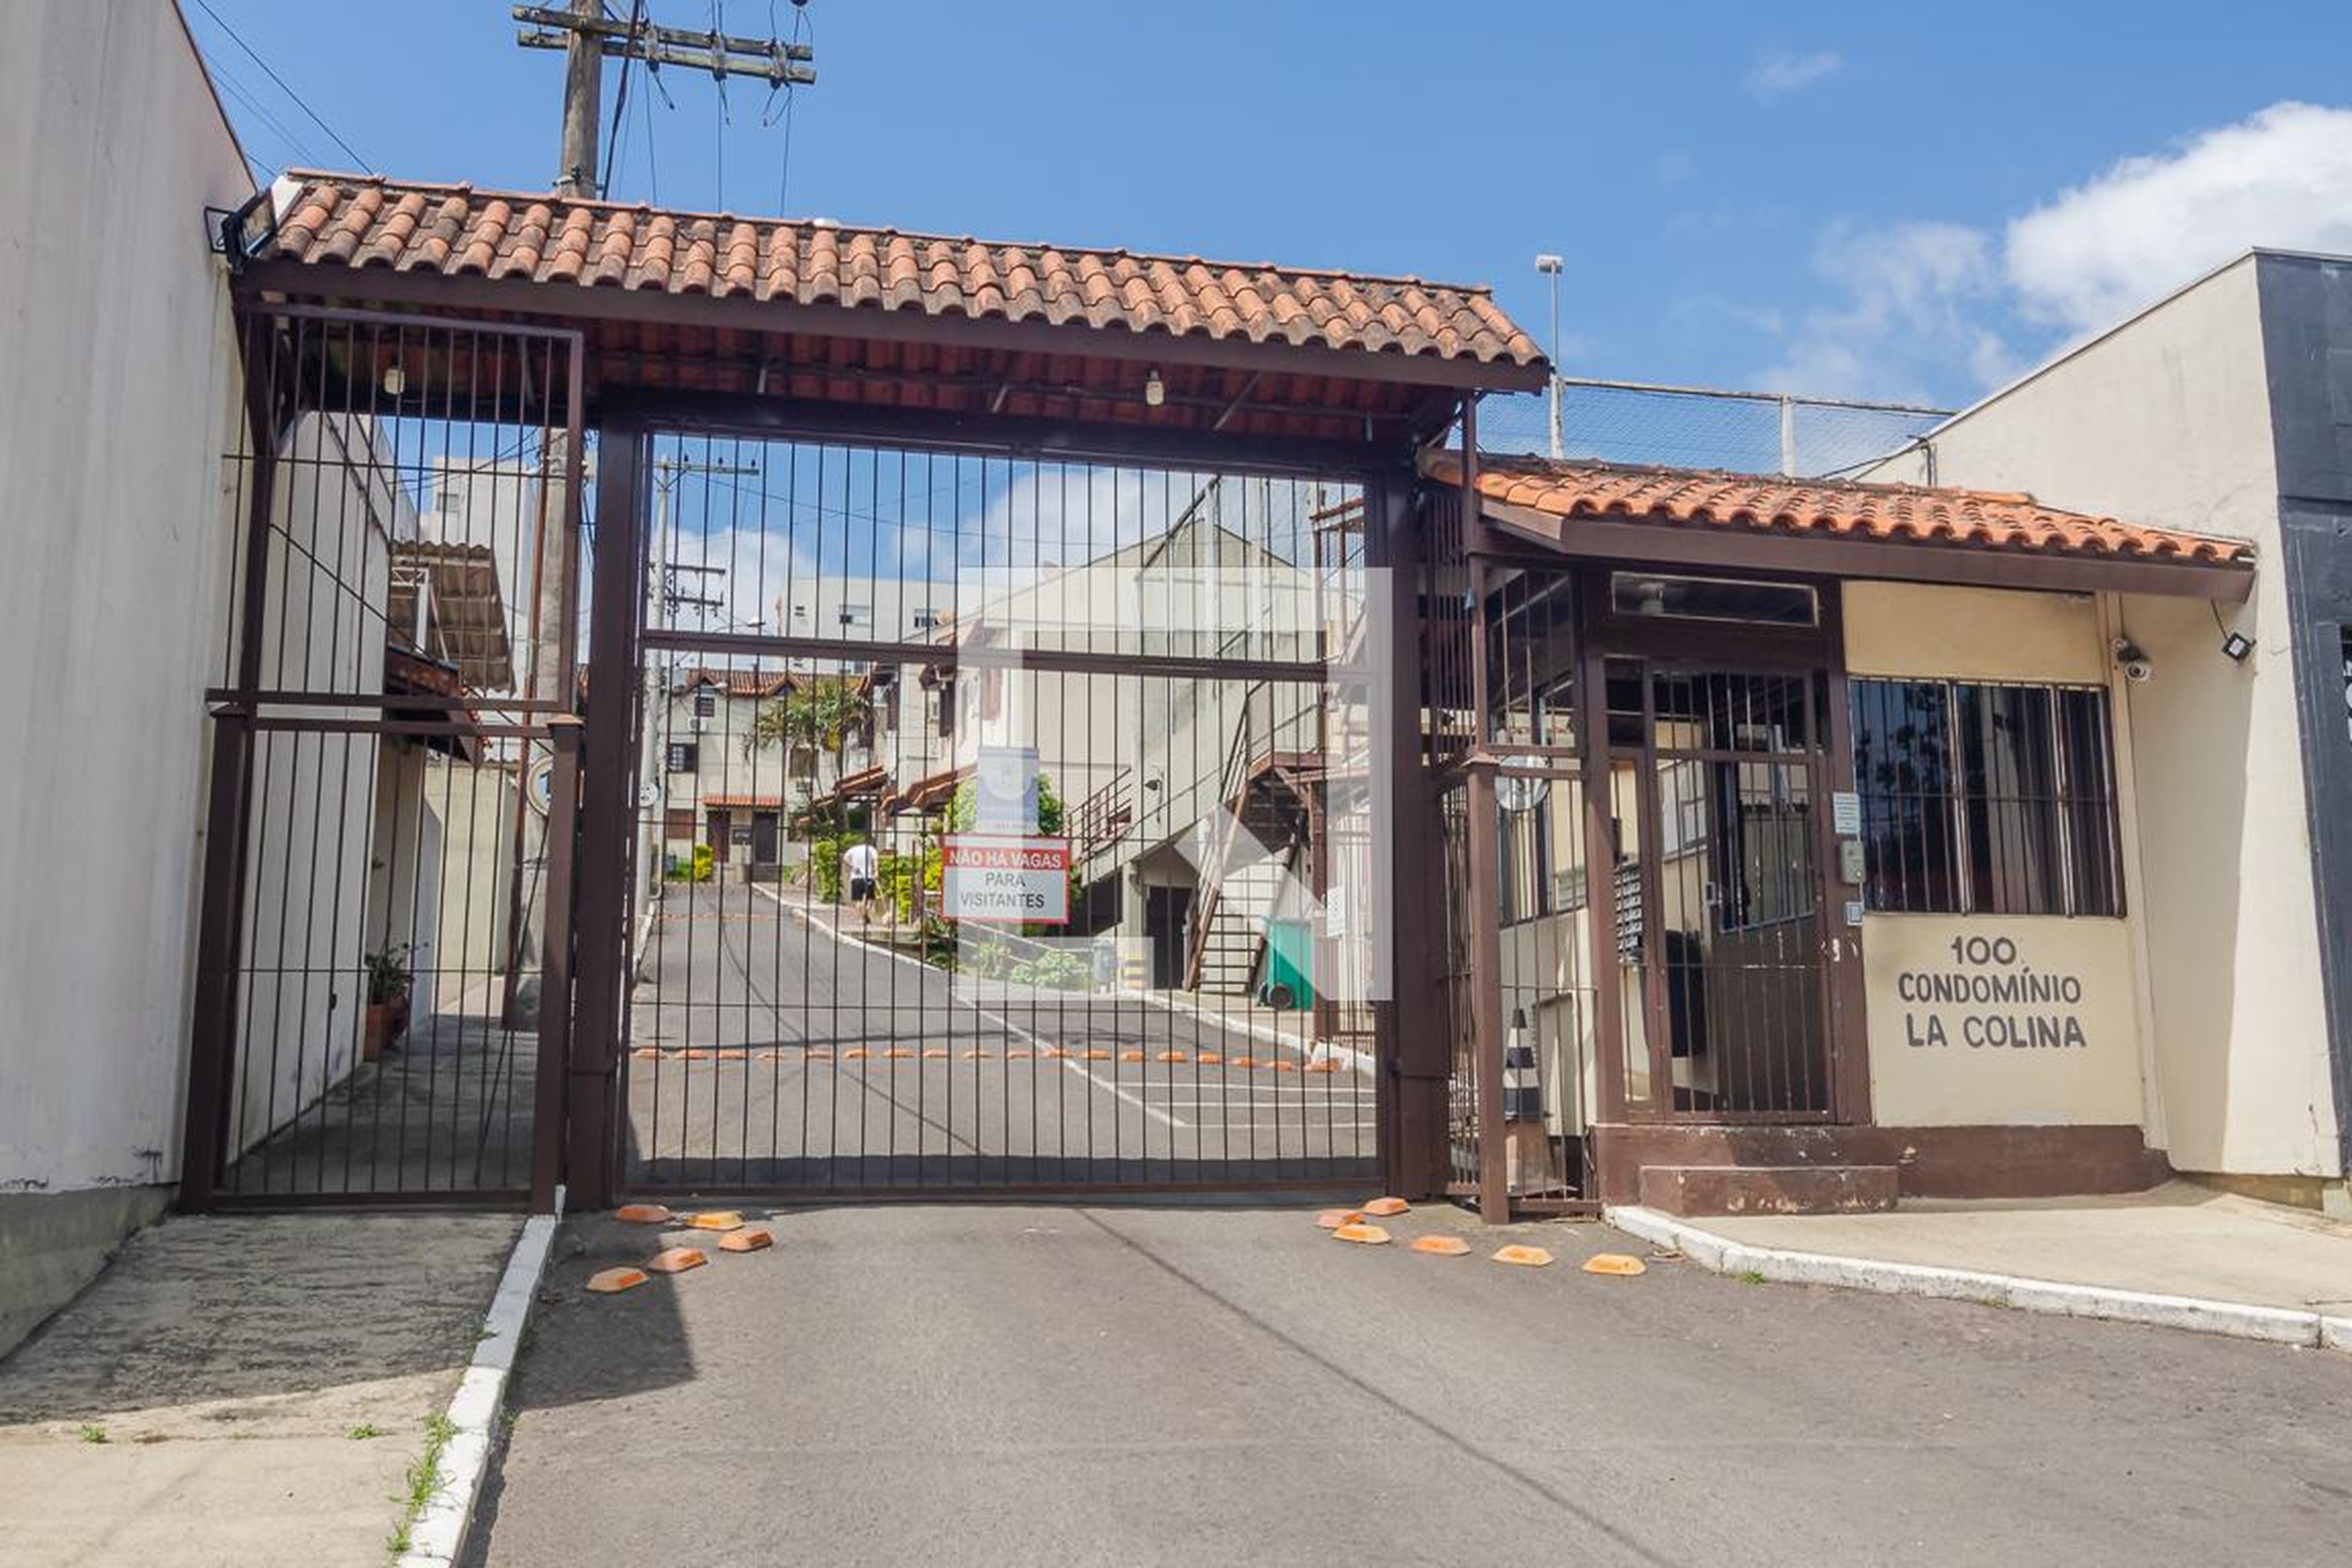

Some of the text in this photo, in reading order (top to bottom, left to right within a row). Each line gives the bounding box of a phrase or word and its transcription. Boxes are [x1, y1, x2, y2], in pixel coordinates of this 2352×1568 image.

[1011, 851, 1062, 869] VAGAS
[985, 872, 1026, 888] PARA
[960, 892, 1045, 909] VISITANTES
[1898, 966, 2081, 1004] CONDOMÍNIO
[1905, 1012, 2087, 1049] LA COLINA
